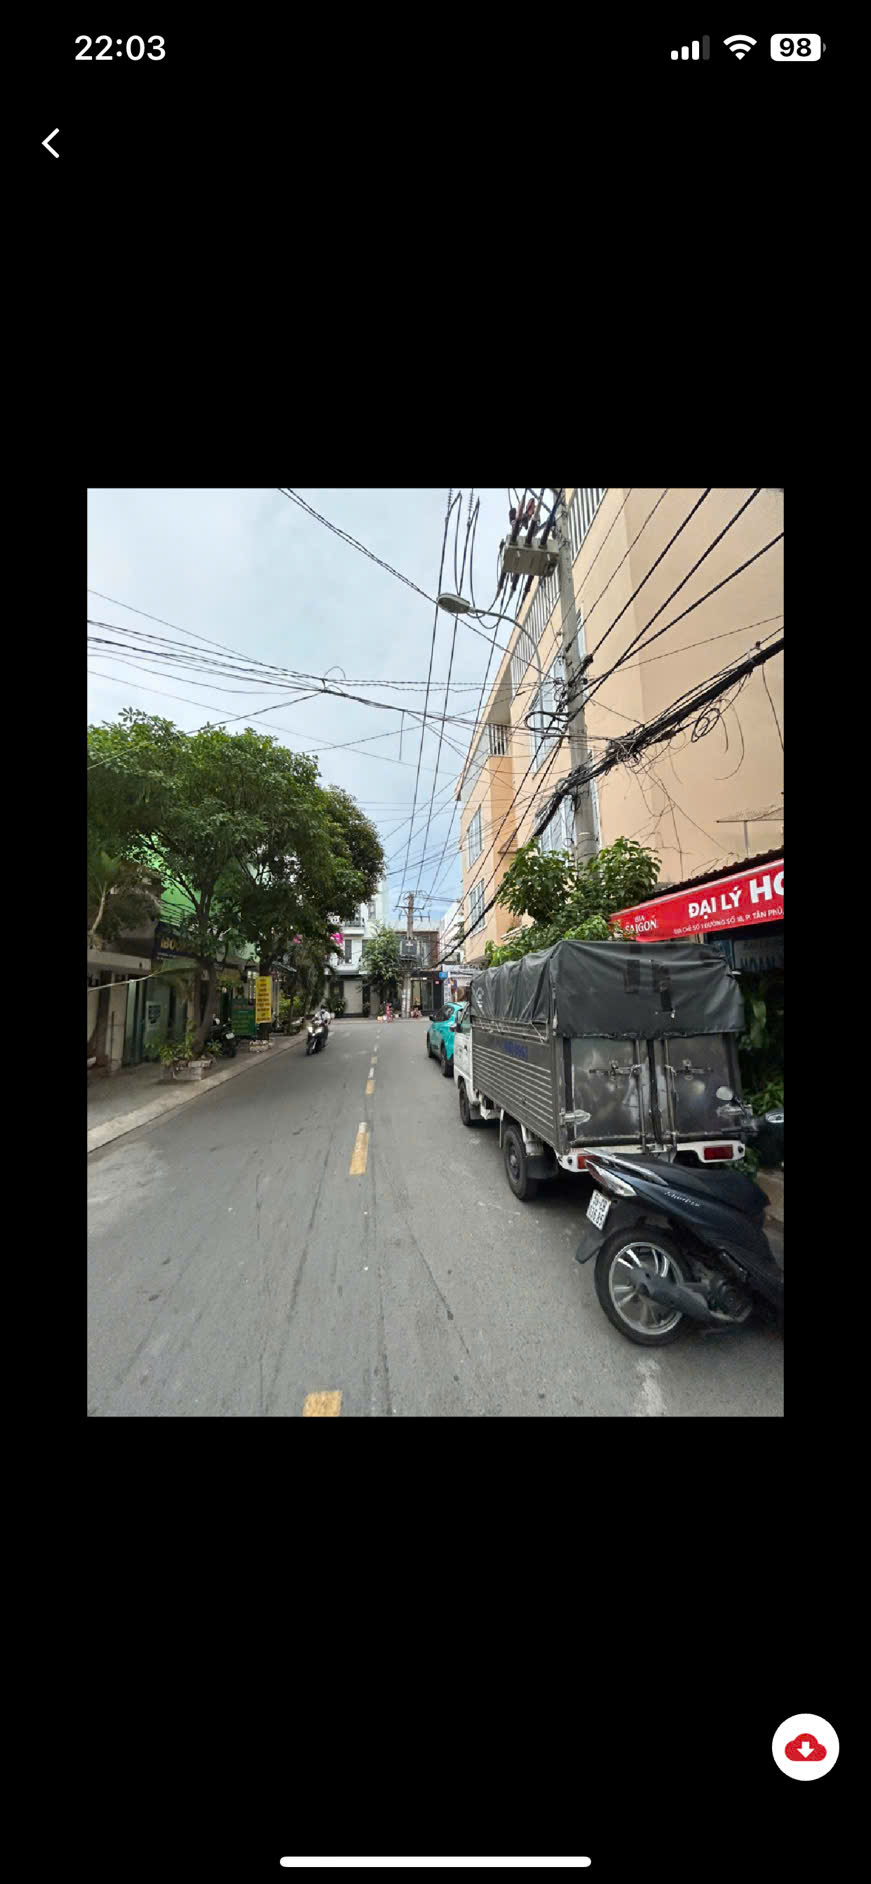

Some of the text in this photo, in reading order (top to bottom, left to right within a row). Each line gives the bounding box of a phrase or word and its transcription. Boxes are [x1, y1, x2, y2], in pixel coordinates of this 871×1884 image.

[688, 897, 717, 919] ĐẠI
[721, 886, 742, 910] LÝ
[752, 911, 767, 919] TÂN
